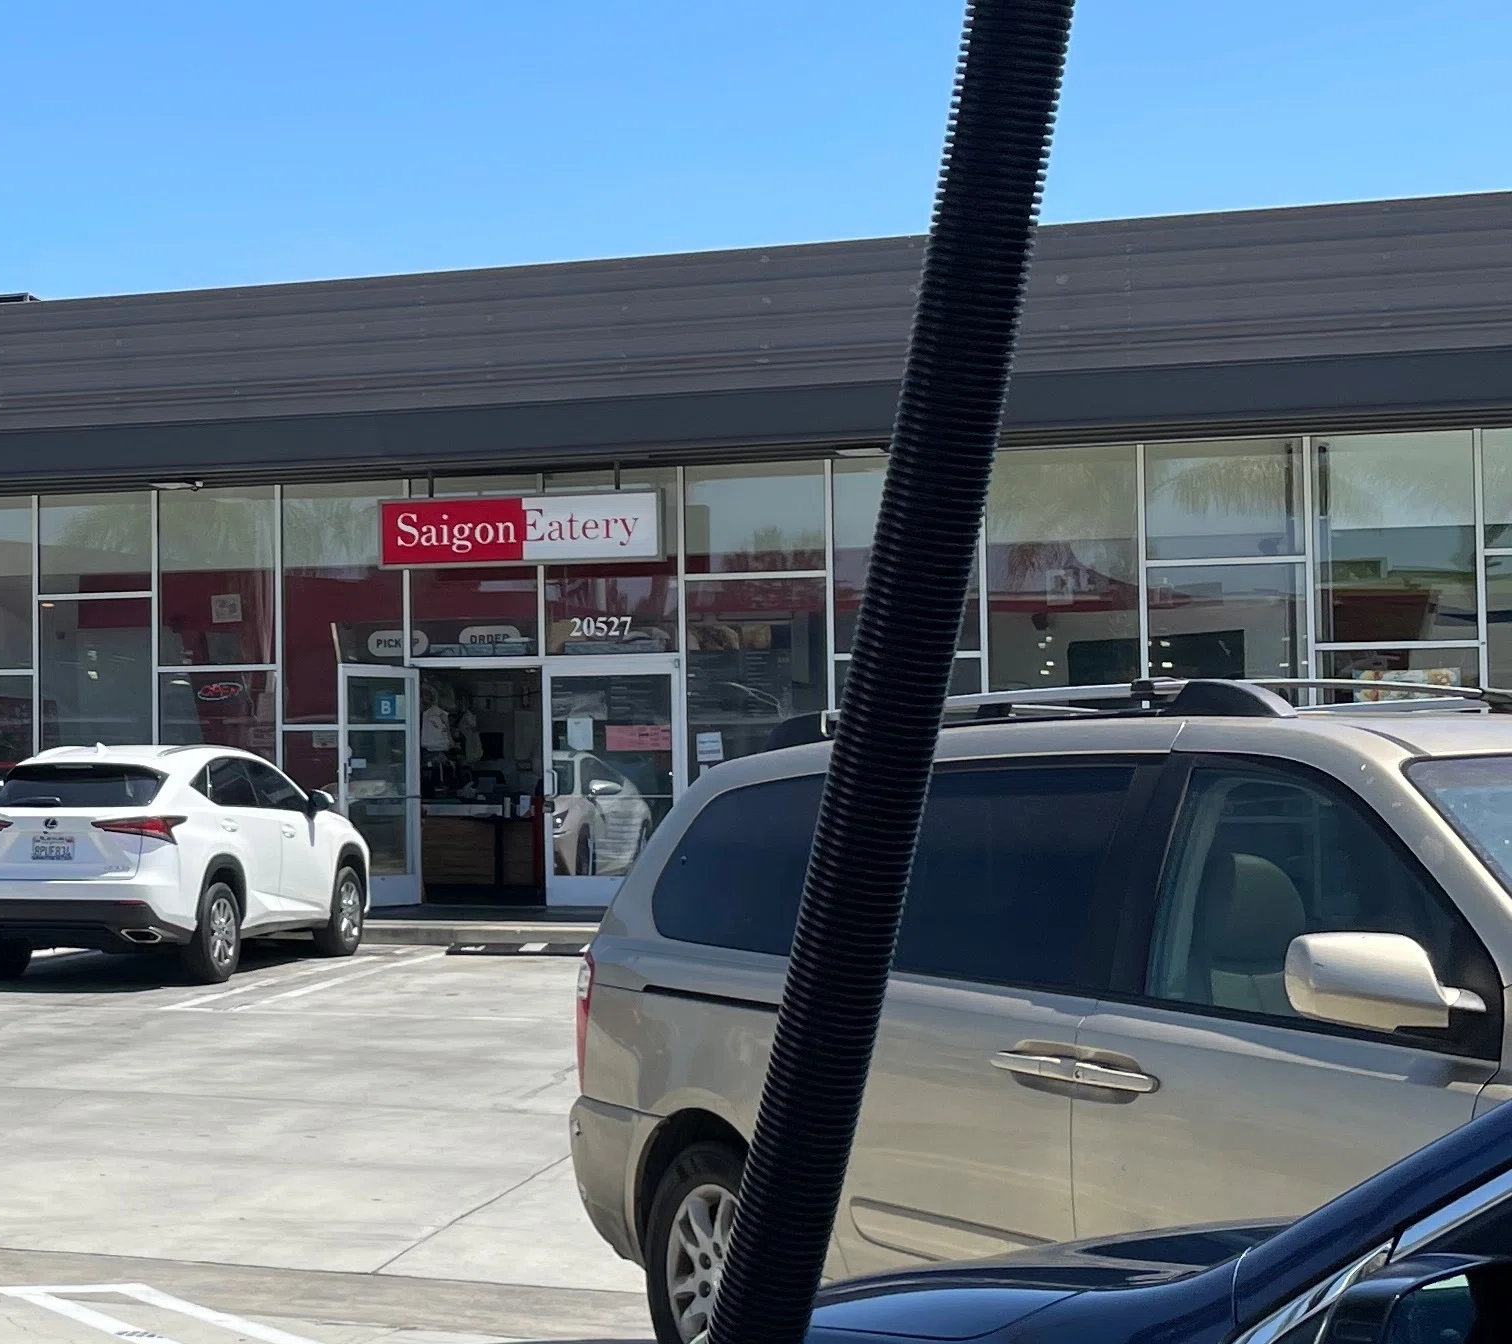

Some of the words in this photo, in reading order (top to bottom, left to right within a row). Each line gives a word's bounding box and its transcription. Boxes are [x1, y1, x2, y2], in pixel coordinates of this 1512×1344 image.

[397, 513, 517, 553] Saigon
[522, 508, 639, 546] Eatery
[569, 616, 633, 637] 20527
[380, 700, 391, 715] B
